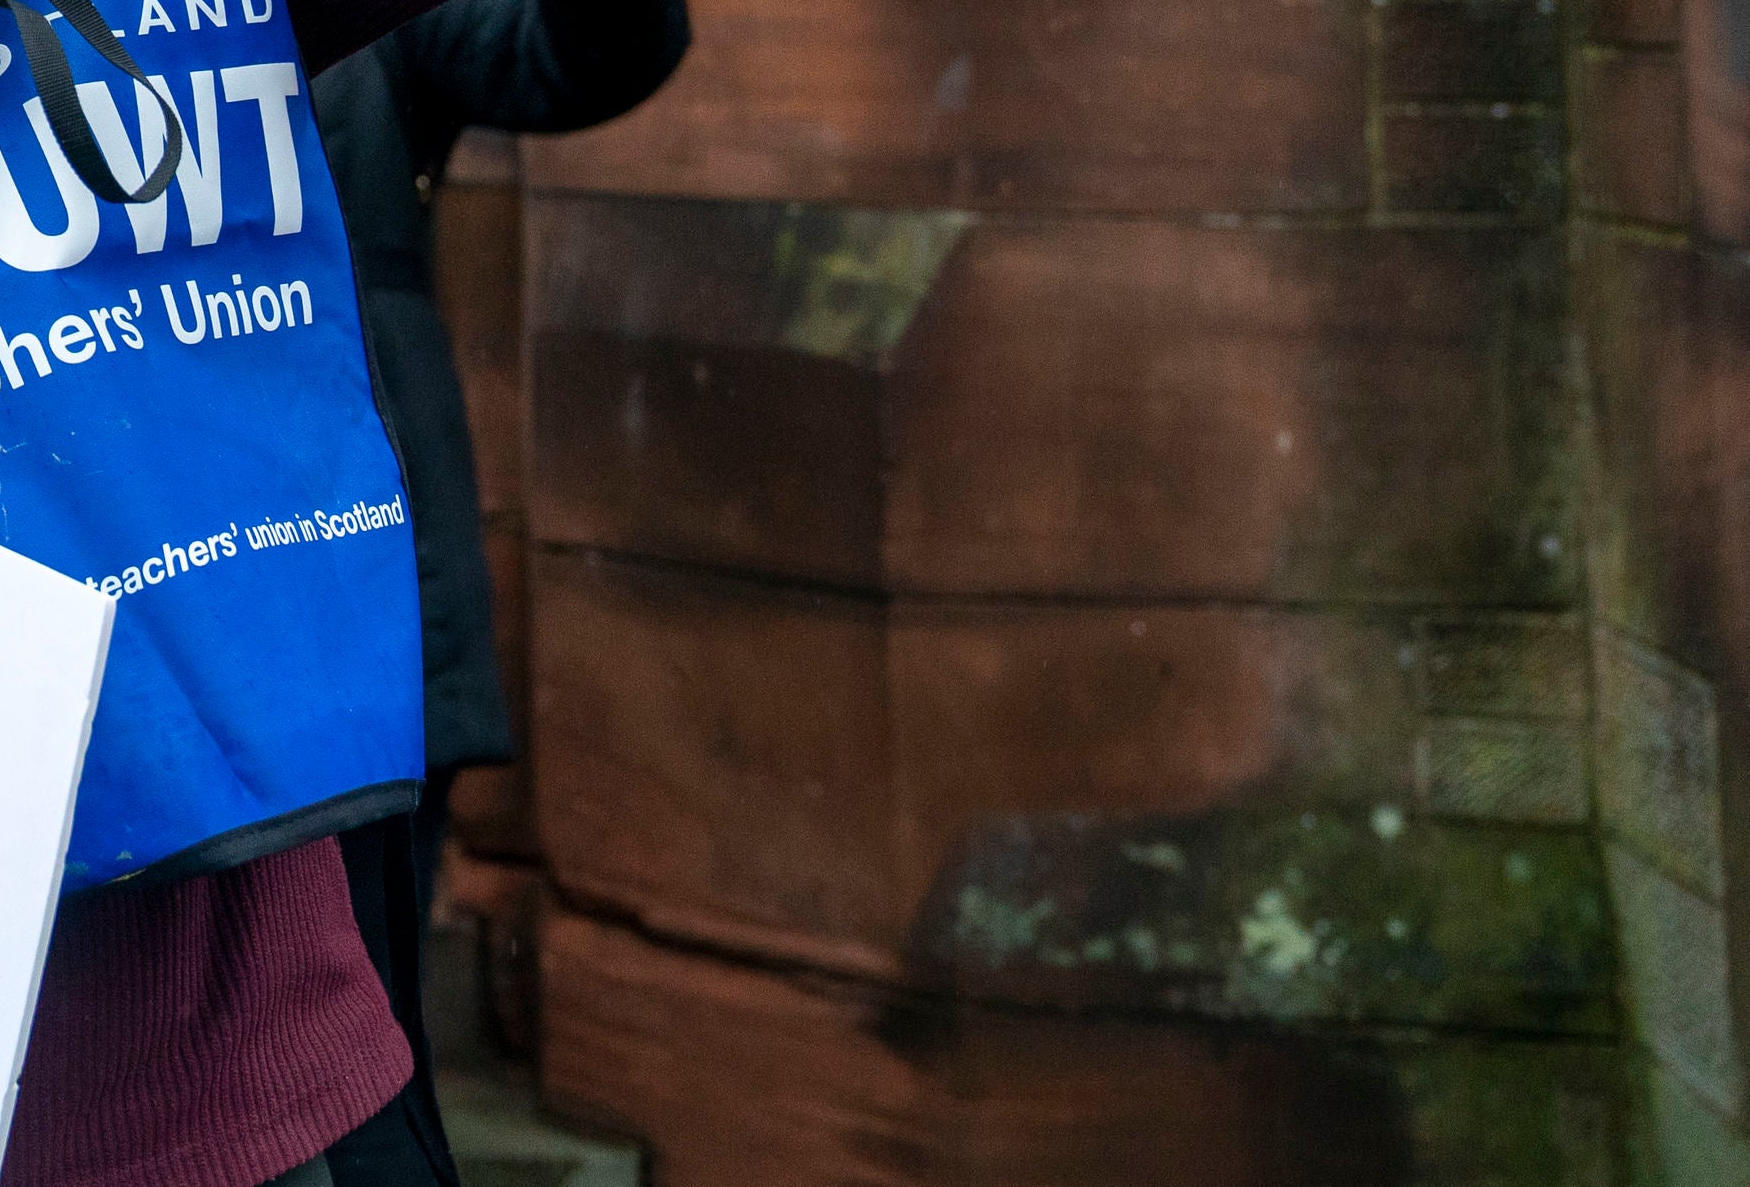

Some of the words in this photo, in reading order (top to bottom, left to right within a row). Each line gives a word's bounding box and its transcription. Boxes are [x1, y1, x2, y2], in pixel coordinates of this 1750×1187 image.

[160, 274, 314, 346] Union
[244, 516, 301, 551] union
[295, 513, 319, 543] in
[312, 493, 406, 541] Scotland
